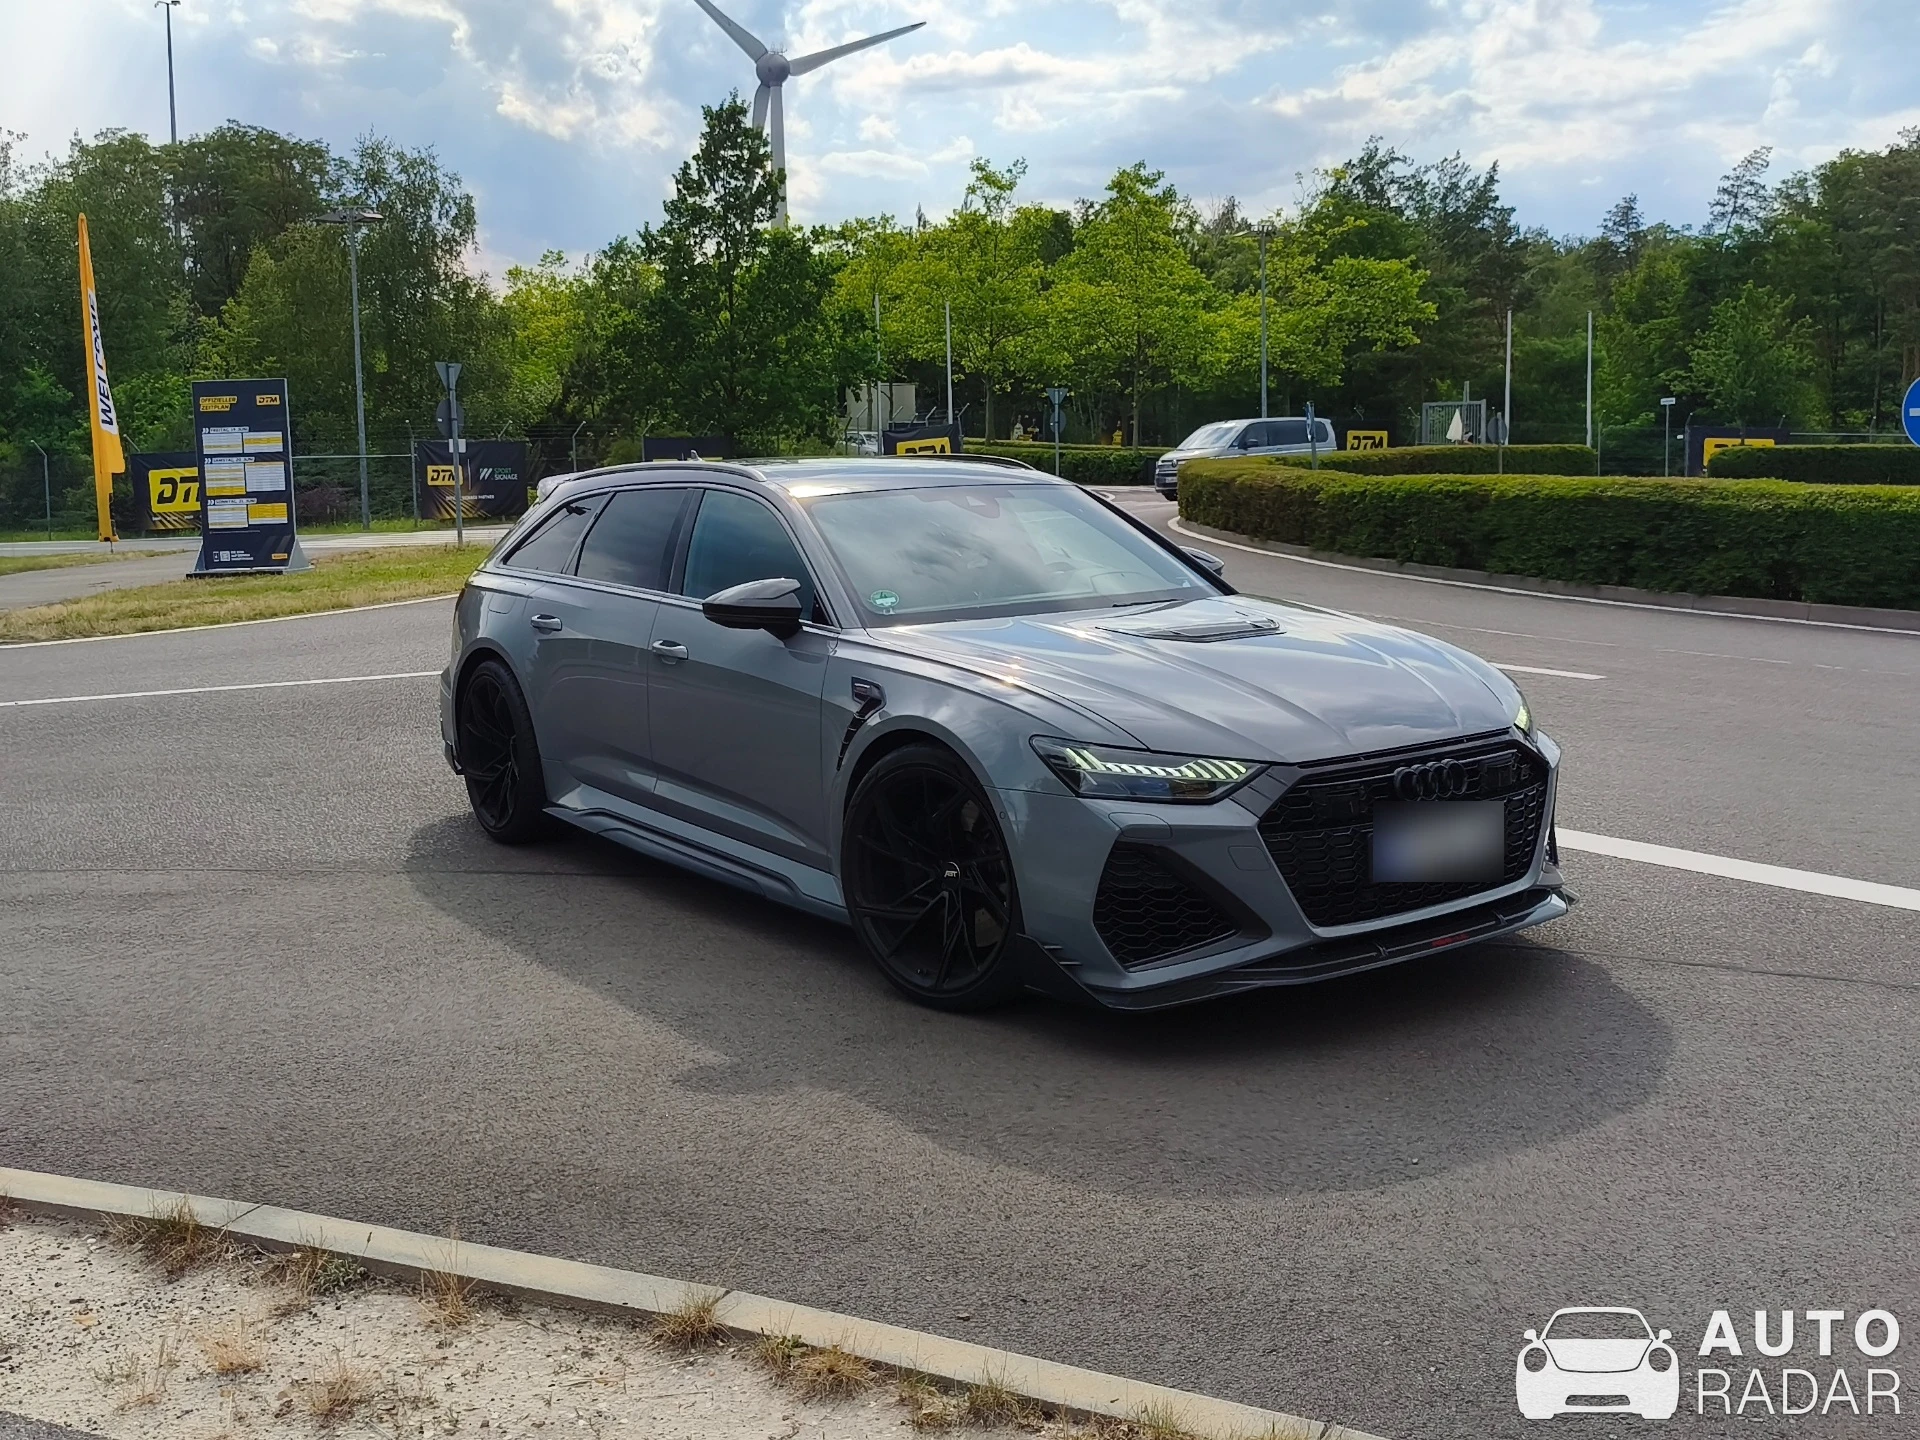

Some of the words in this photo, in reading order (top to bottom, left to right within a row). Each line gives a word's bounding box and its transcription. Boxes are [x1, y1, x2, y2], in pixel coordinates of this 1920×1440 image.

[258, 396, 278, 404] DTM
[1349, 435, 1384, 451] DTM
[156, 476, 200, 505] DT
